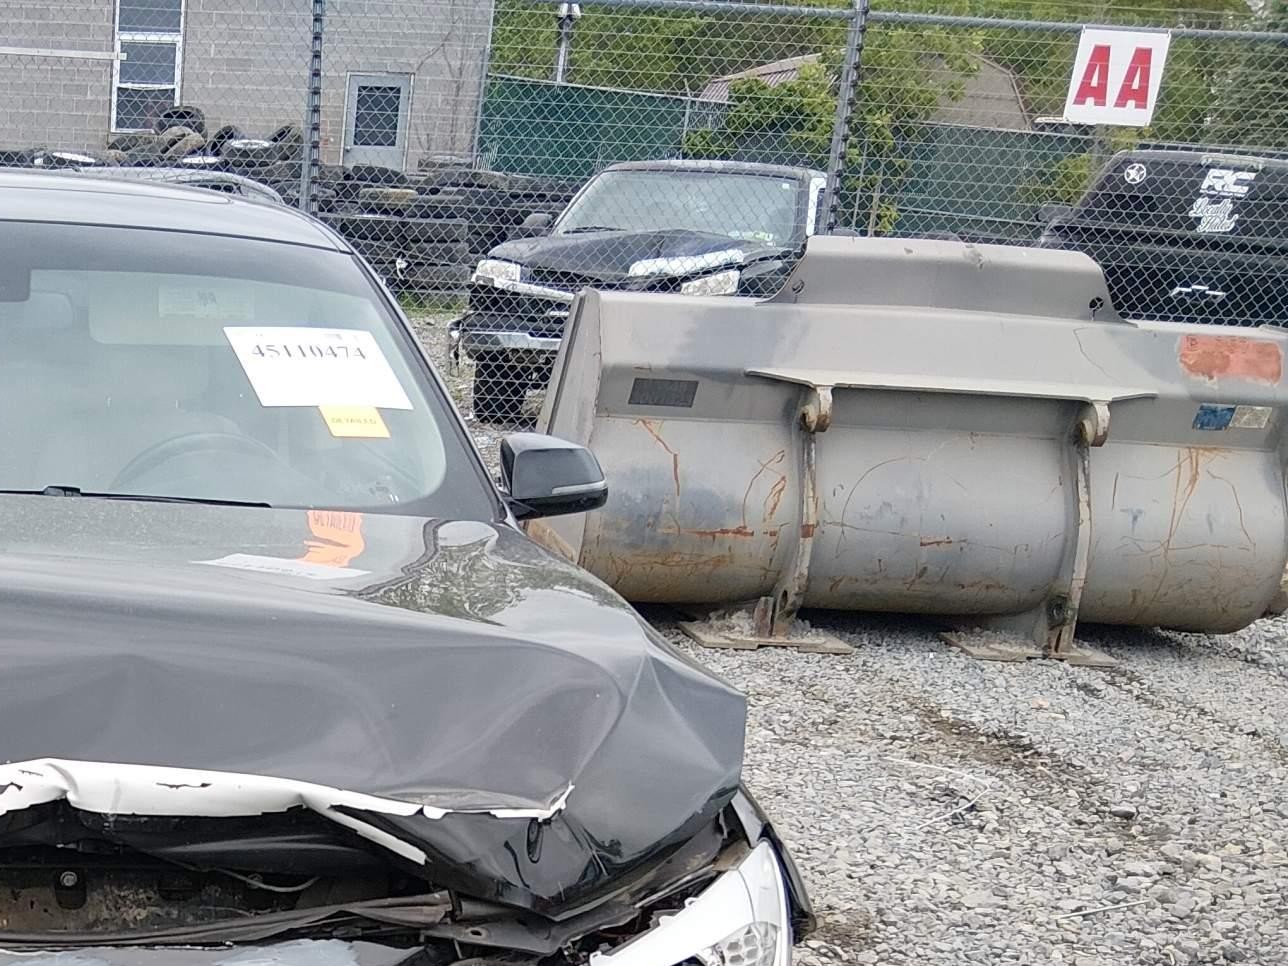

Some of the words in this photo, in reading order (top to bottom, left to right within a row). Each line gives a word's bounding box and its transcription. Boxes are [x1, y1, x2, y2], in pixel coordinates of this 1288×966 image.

[1072, 44, 1153, 109] AA
[1200, 168, 1257, 193] RC
[251, 344, 367, 360] 45110474
